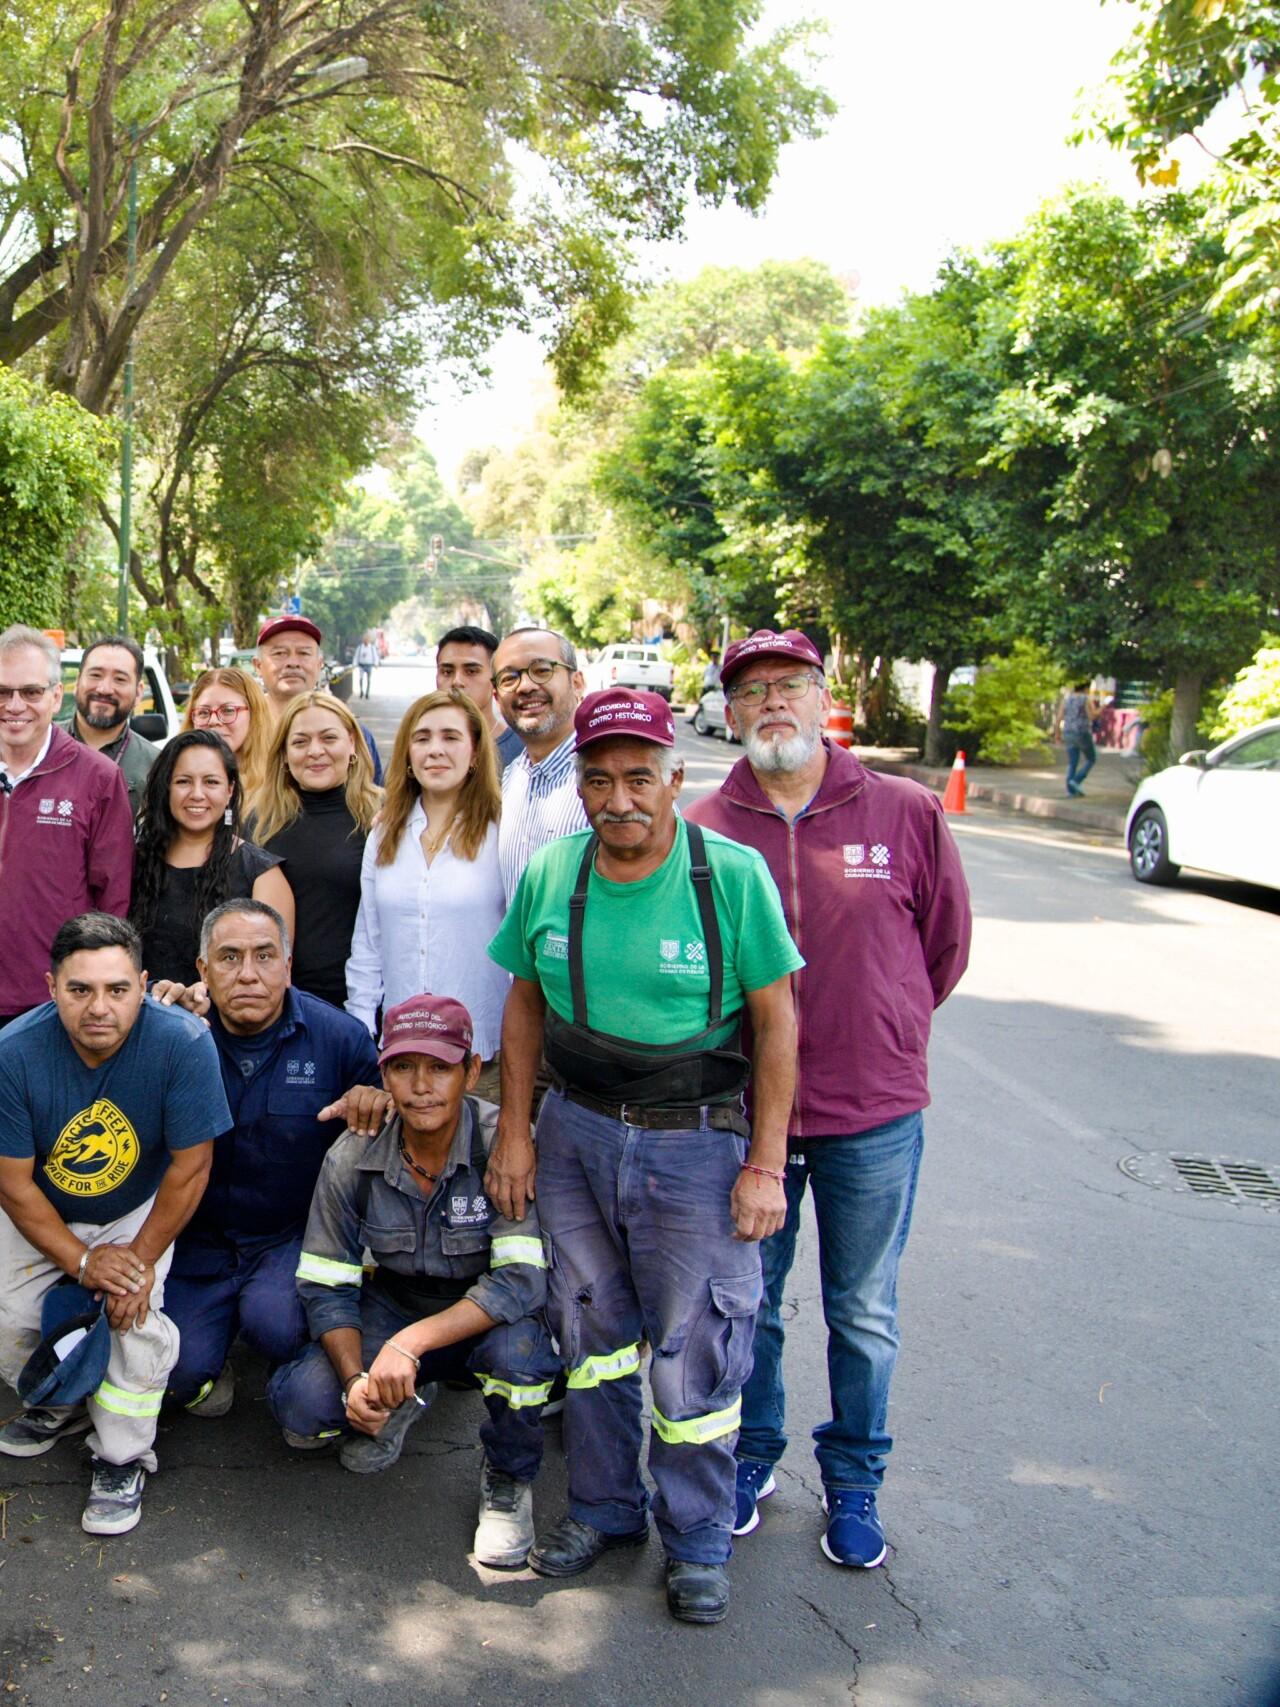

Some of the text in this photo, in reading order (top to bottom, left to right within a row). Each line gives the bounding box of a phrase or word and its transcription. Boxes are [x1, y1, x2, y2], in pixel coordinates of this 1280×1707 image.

[593, 702, 648, 714] AUTORIDAD DEL
[588, 710, 652, 728] CENTRO HISTÓRICO
[397, 1011, 442, 1021] AUTORIDAD DEL
[67, 1179, 92, 1192] FOR
[107, 1160, 130, 1183] RIDE
